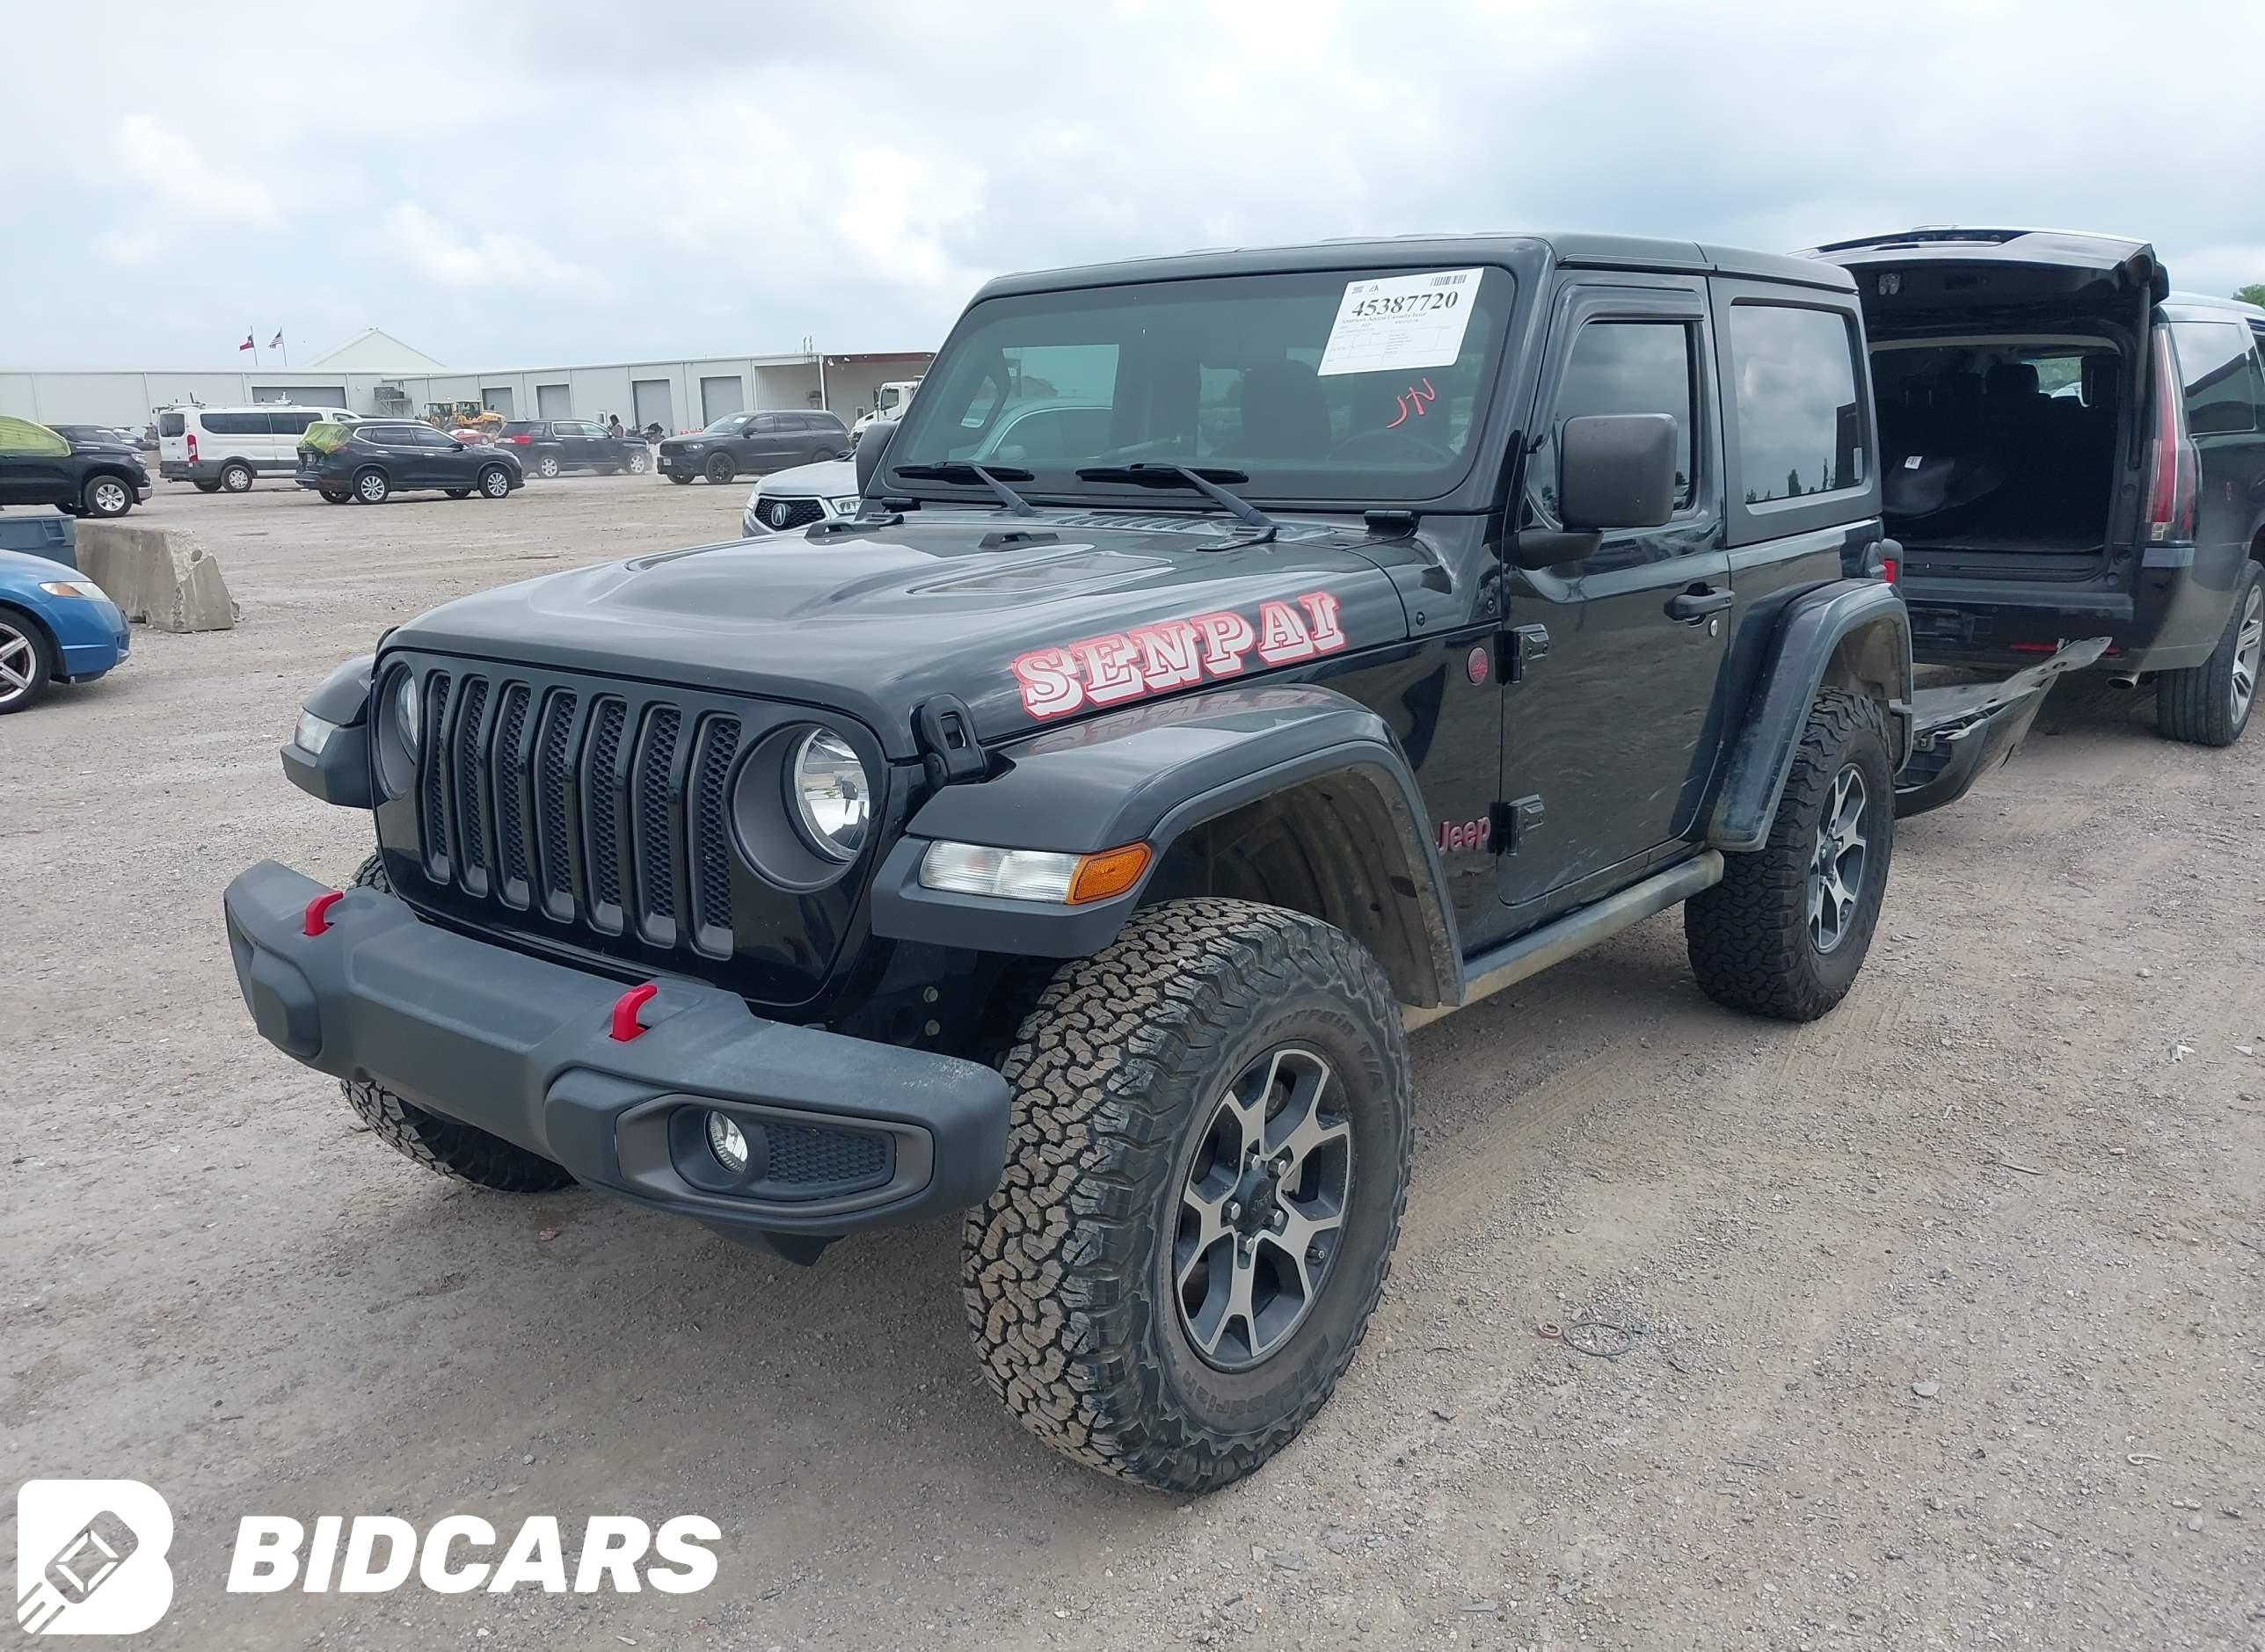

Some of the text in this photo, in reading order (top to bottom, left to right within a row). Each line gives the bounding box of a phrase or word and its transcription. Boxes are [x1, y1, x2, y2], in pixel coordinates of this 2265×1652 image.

[1351, 291, 1459, 317] 45387720
[1011, 590, 1347, 722] SENPAI
[1436, 817, 1491, 856] Jeep
